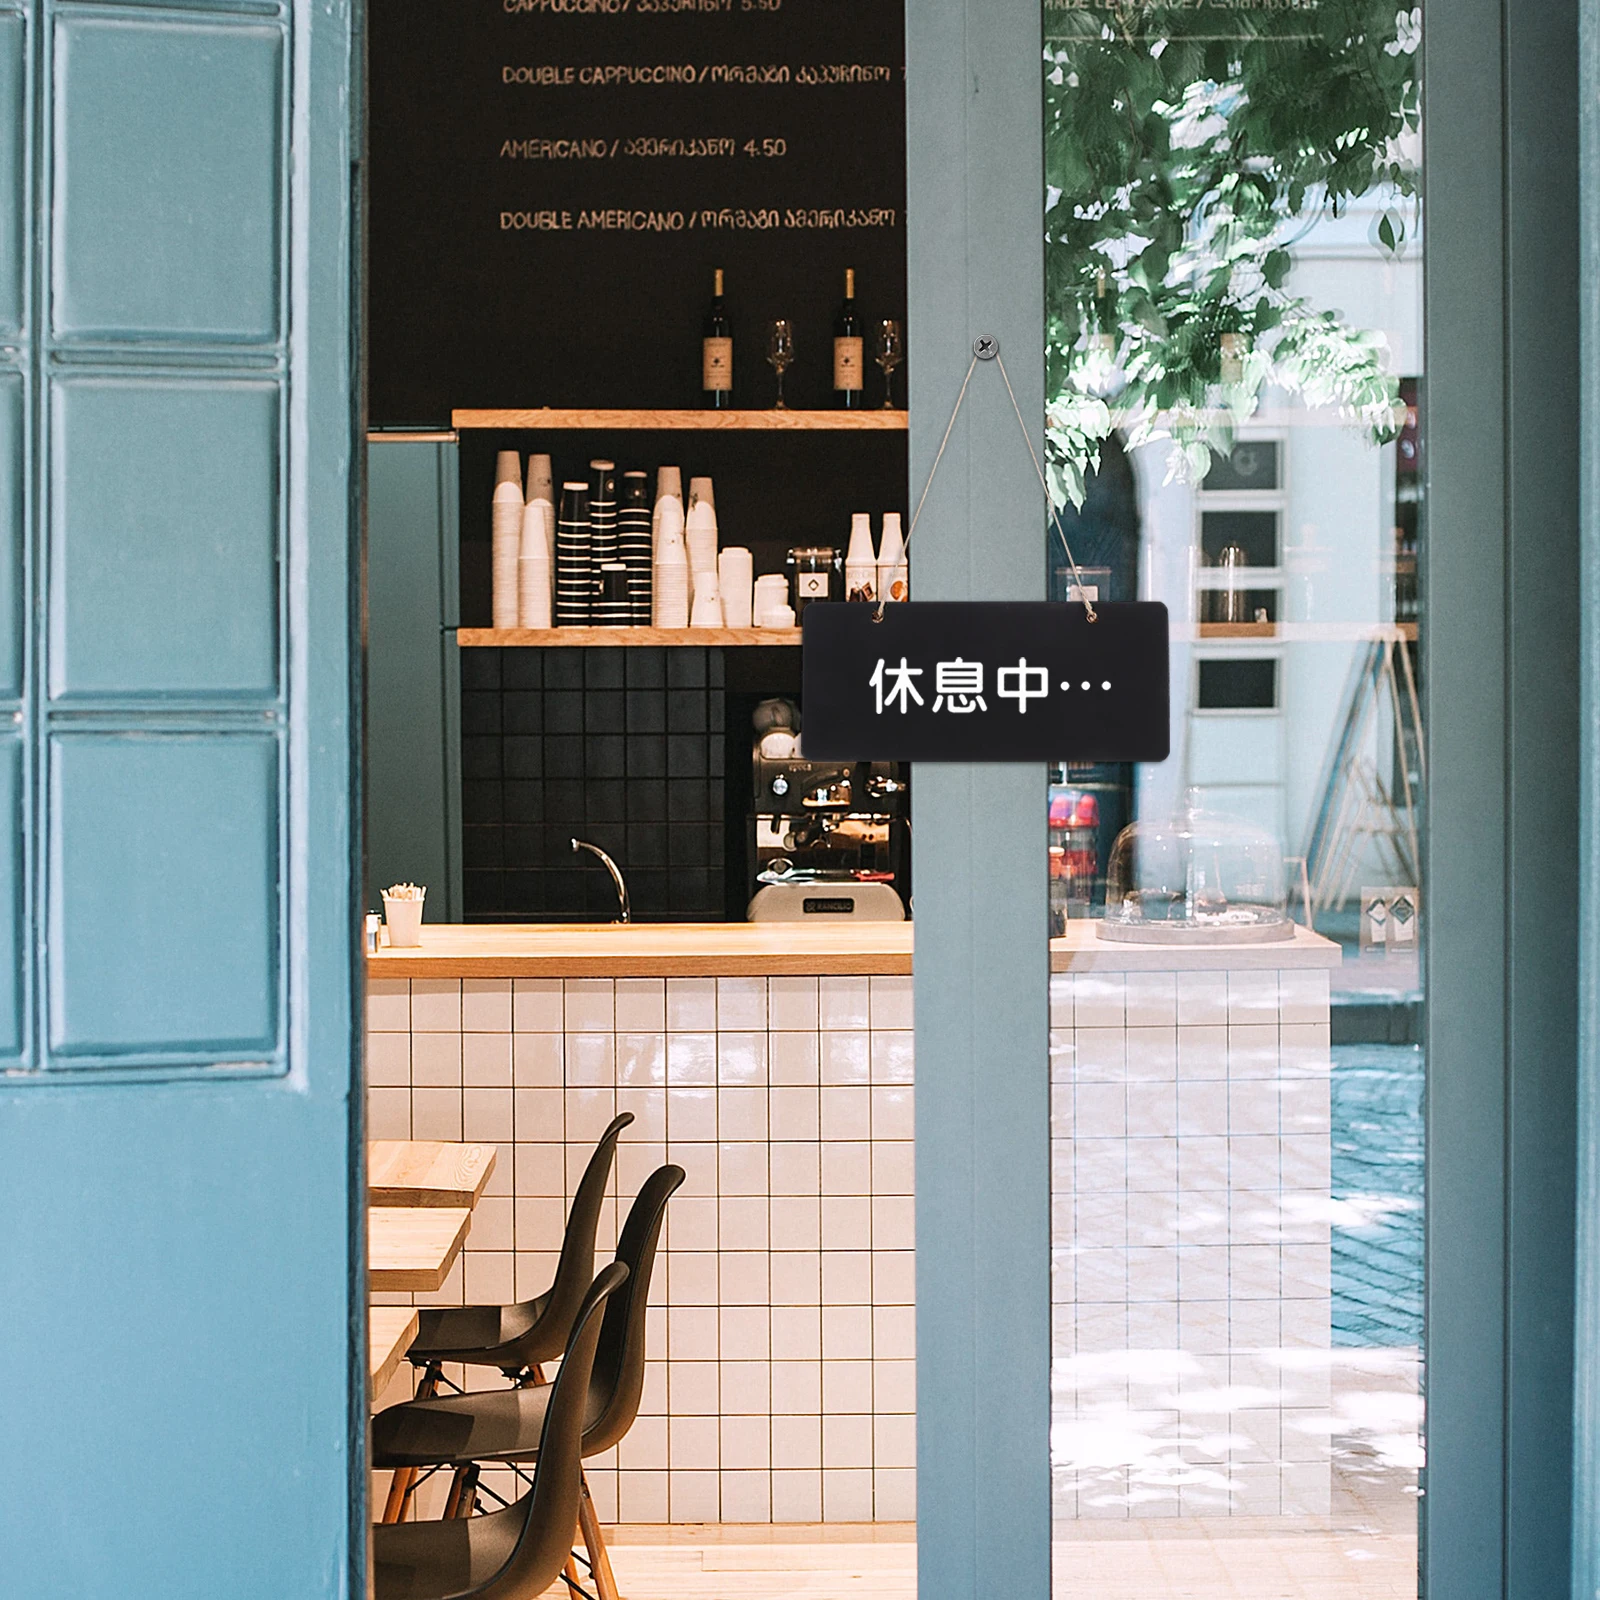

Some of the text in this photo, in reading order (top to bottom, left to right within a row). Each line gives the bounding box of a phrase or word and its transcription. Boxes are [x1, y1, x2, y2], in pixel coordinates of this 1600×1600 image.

[502, 66, 575, 85] DOUBLE
[743, 138, 787, 157] 4.50
[500, 210, 573, 230] DOUBLE
